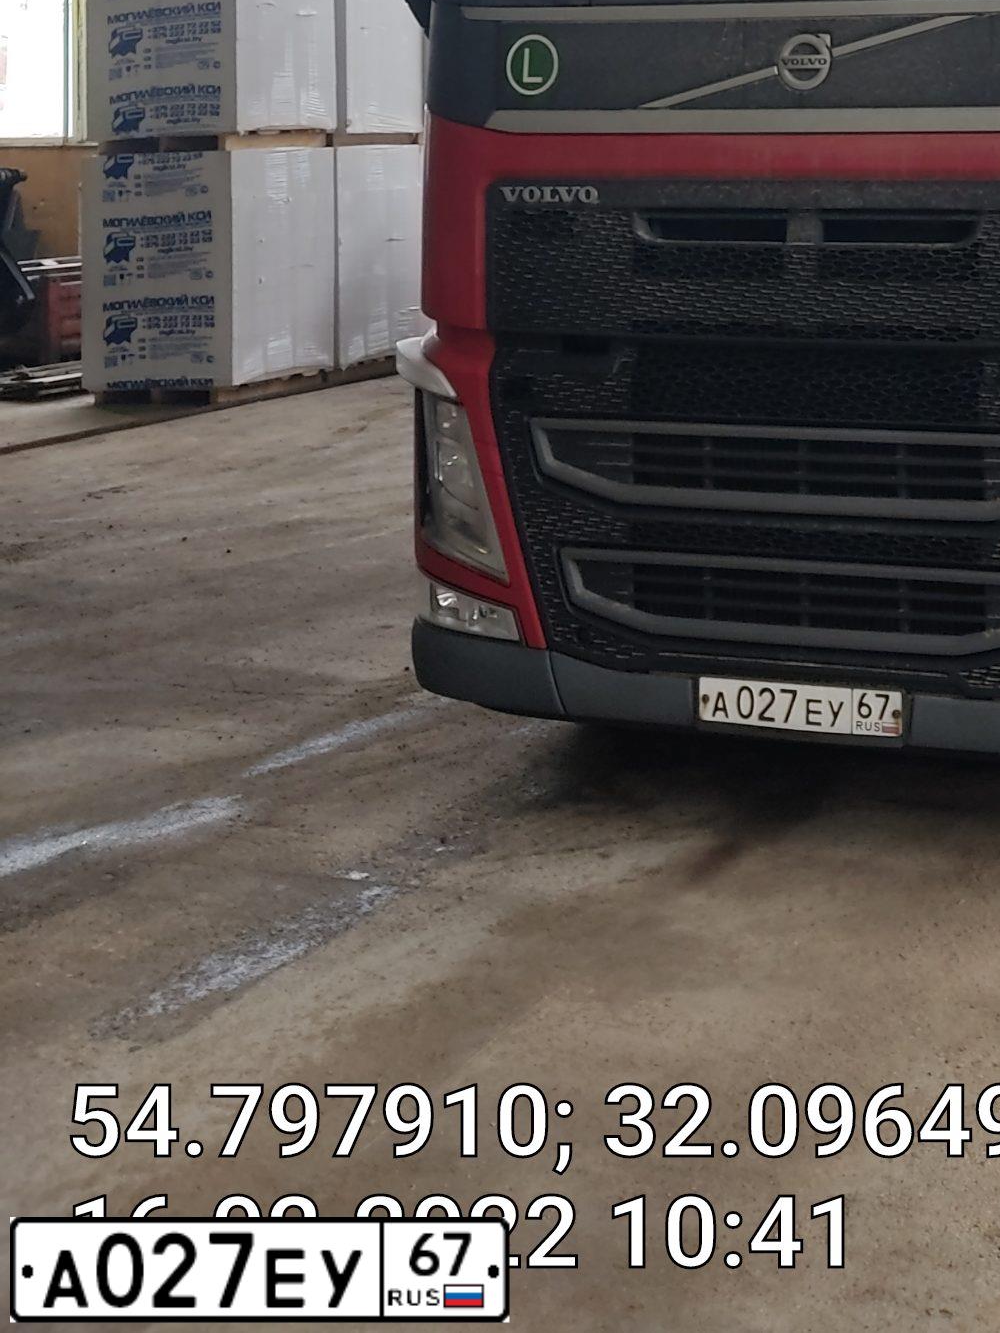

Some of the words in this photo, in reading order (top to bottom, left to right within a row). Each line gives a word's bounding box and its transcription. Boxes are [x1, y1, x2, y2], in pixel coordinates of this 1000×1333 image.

[522, 48, 543, 83] L
[781, 58, 828, 66] VOLVO
[500, 186, 599, 204] VOLVO
[712, 685, 844, 727] А027ЕУ
[856, 692, 890, 720] 67
[855, 720, 881, 732] RUS
